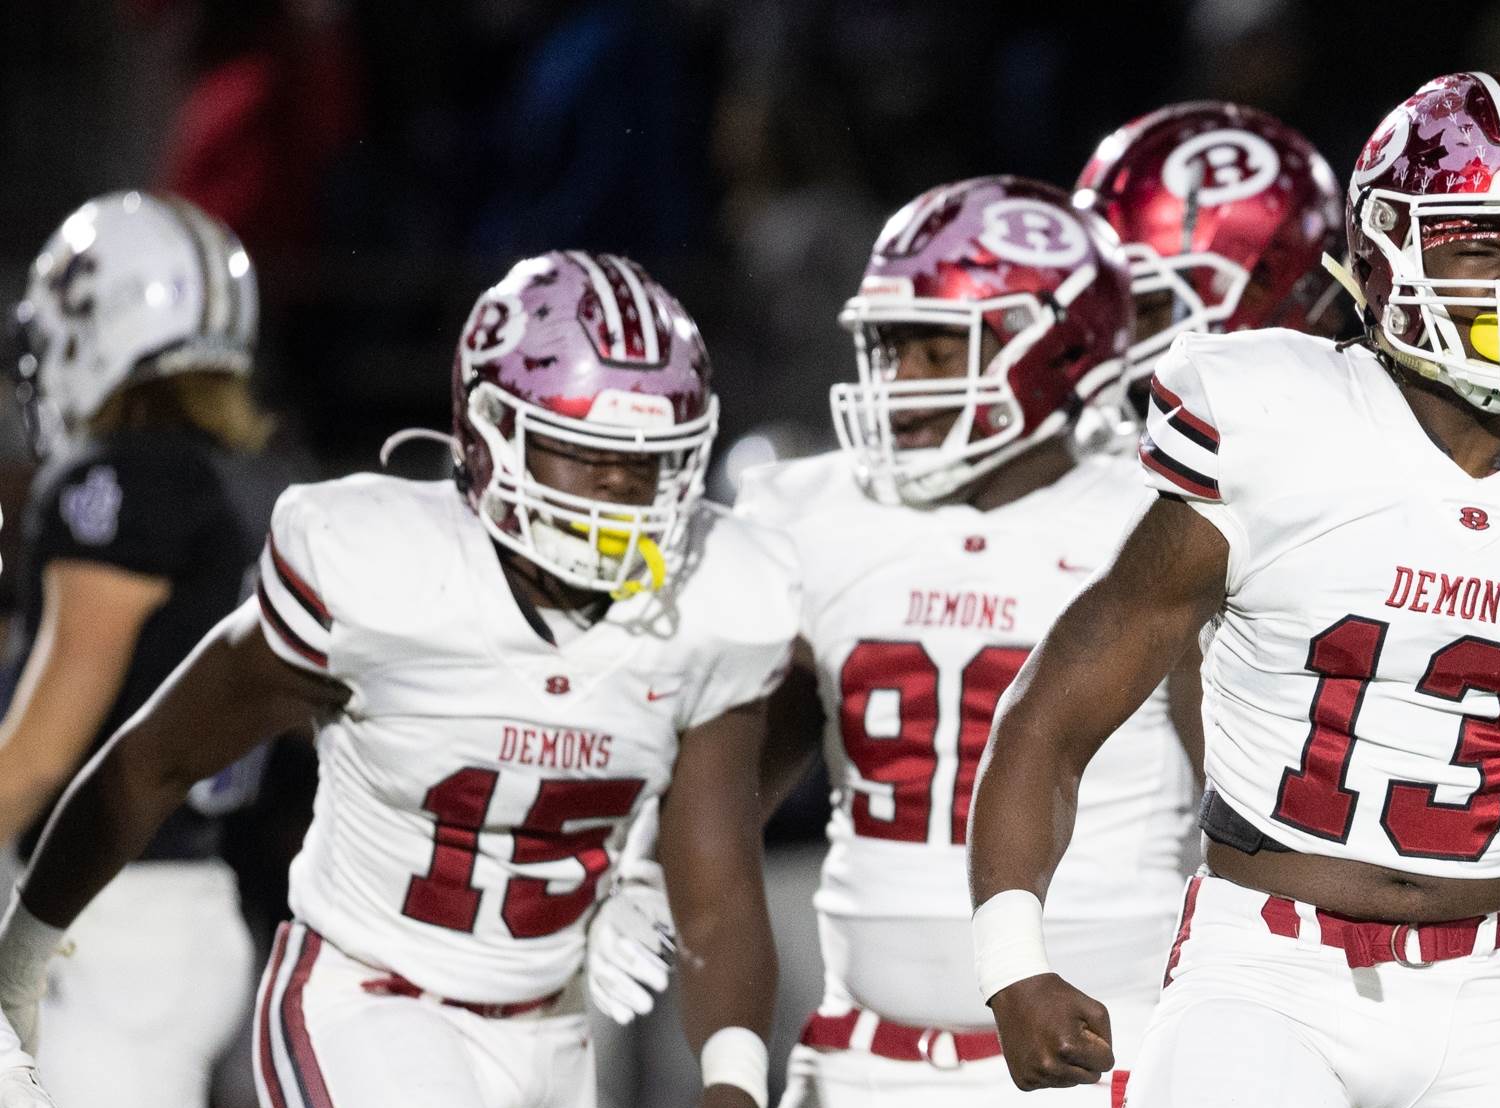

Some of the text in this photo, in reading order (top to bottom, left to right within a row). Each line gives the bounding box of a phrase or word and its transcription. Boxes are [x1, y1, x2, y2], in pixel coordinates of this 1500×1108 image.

[996, 209, 1073, 253] R
[1459, 506, 1491, 531] R
[903, 590, 1017, 632] DEMONS
[497, 725, 615, 770] DEMONS
[400, 766, 648, 940] 15
